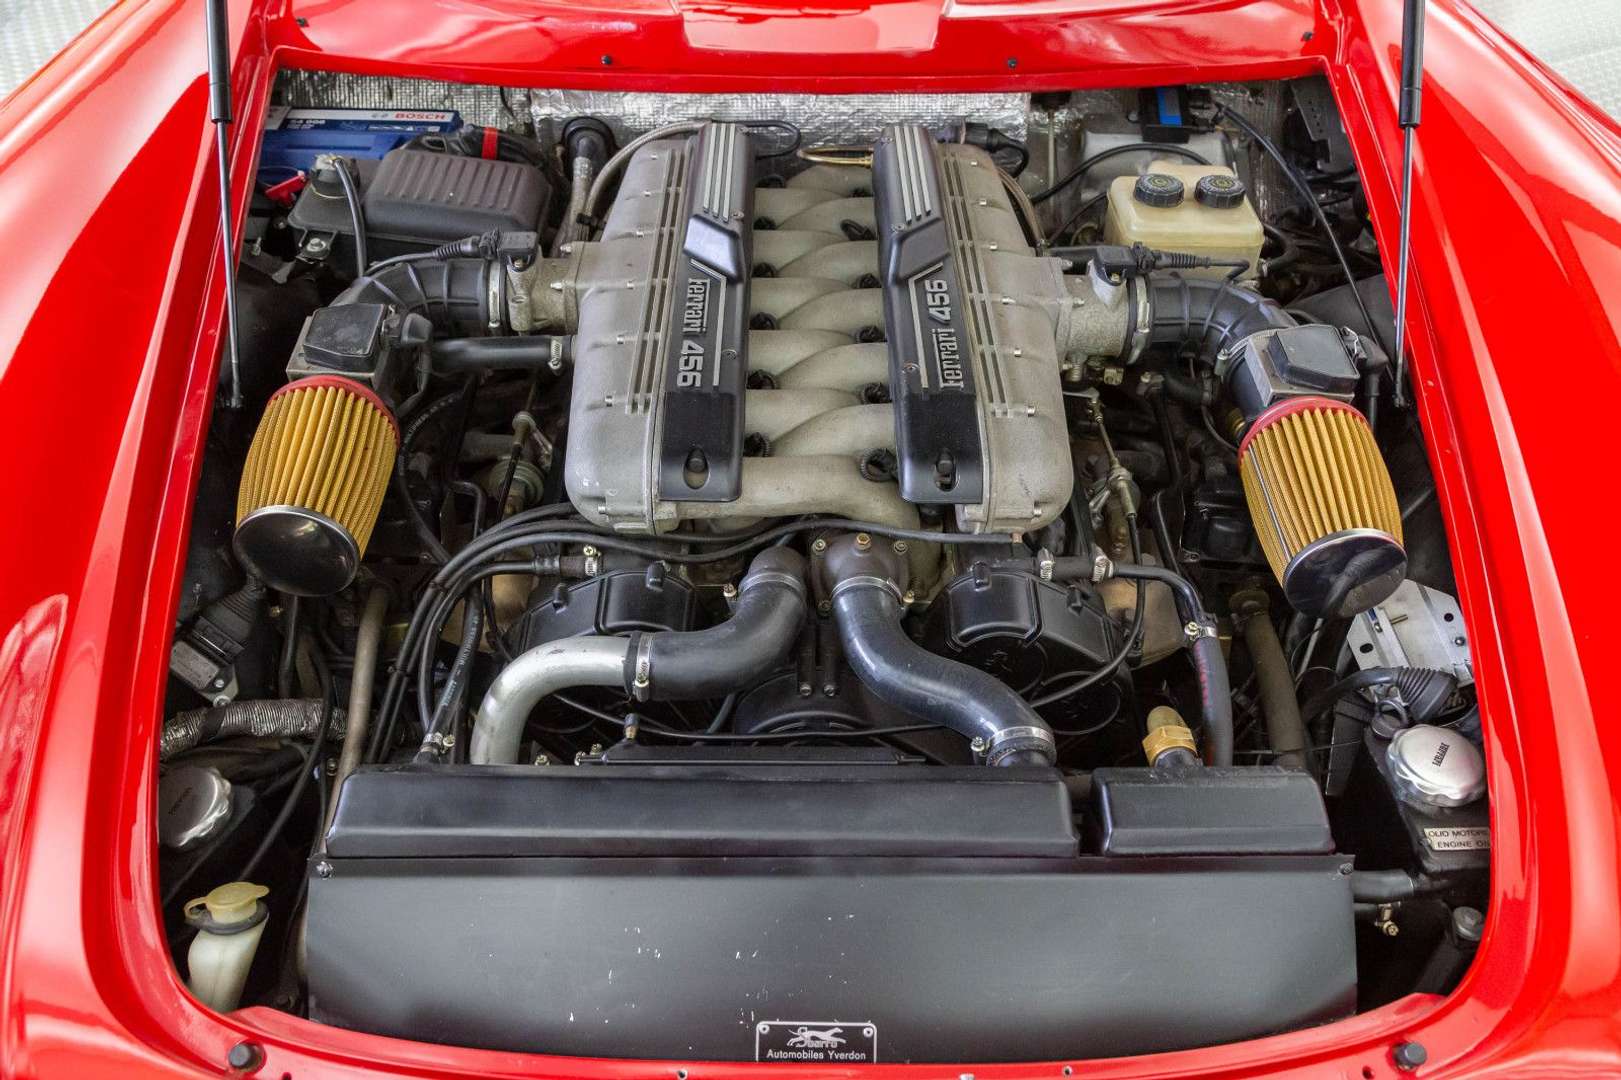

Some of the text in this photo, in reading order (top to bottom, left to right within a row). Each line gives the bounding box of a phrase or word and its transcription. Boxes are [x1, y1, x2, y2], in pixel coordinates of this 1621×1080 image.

[677, 278, 710, 387] Ferrari 456
[925, 280, 964, 388] Ferrari 456
[1437, 841, 1473, 849] ENGINE
[766, 1048, 867, 1060] Automobiles Yverdon
